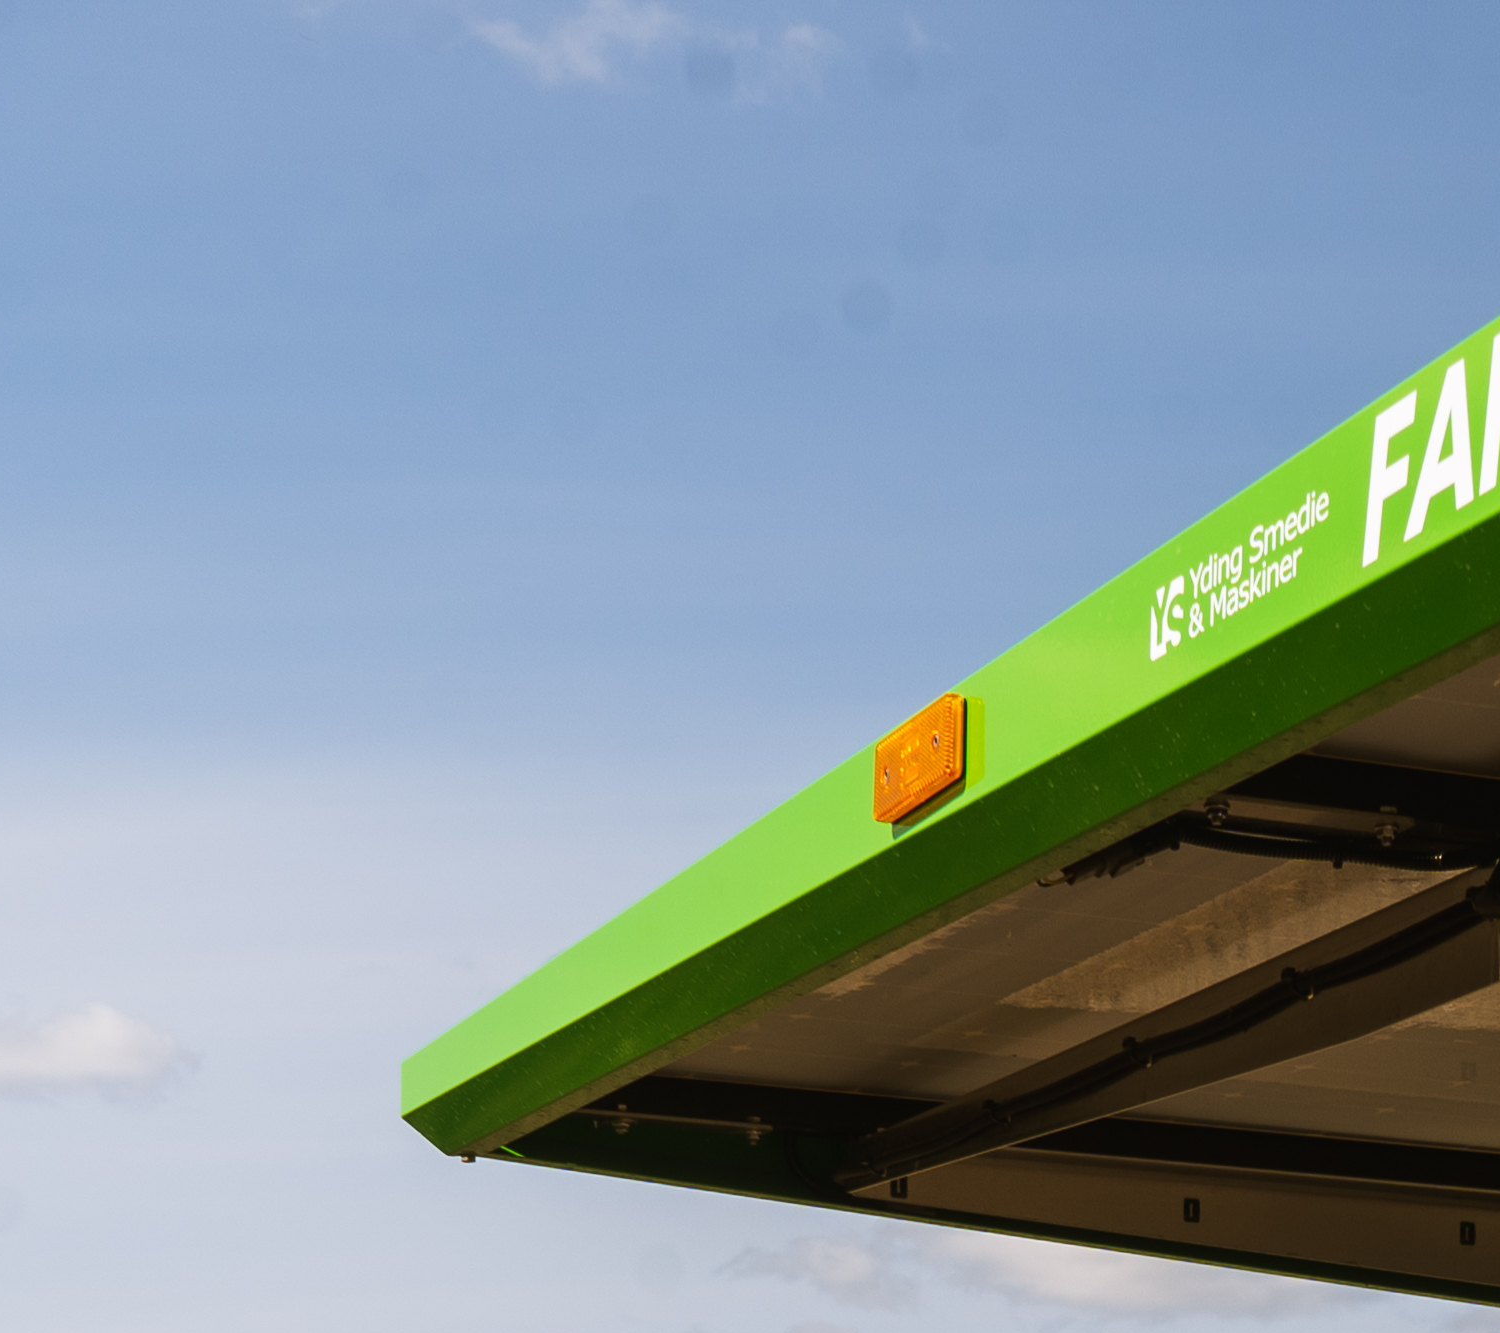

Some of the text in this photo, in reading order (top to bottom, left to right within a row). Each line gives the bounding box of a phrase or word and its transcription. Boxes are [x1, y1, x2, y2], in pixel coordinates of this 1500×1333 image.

[1188, 547, 1303, 638] & Maskiner
[1189, 490, 1329, 599] Yding Smedie
